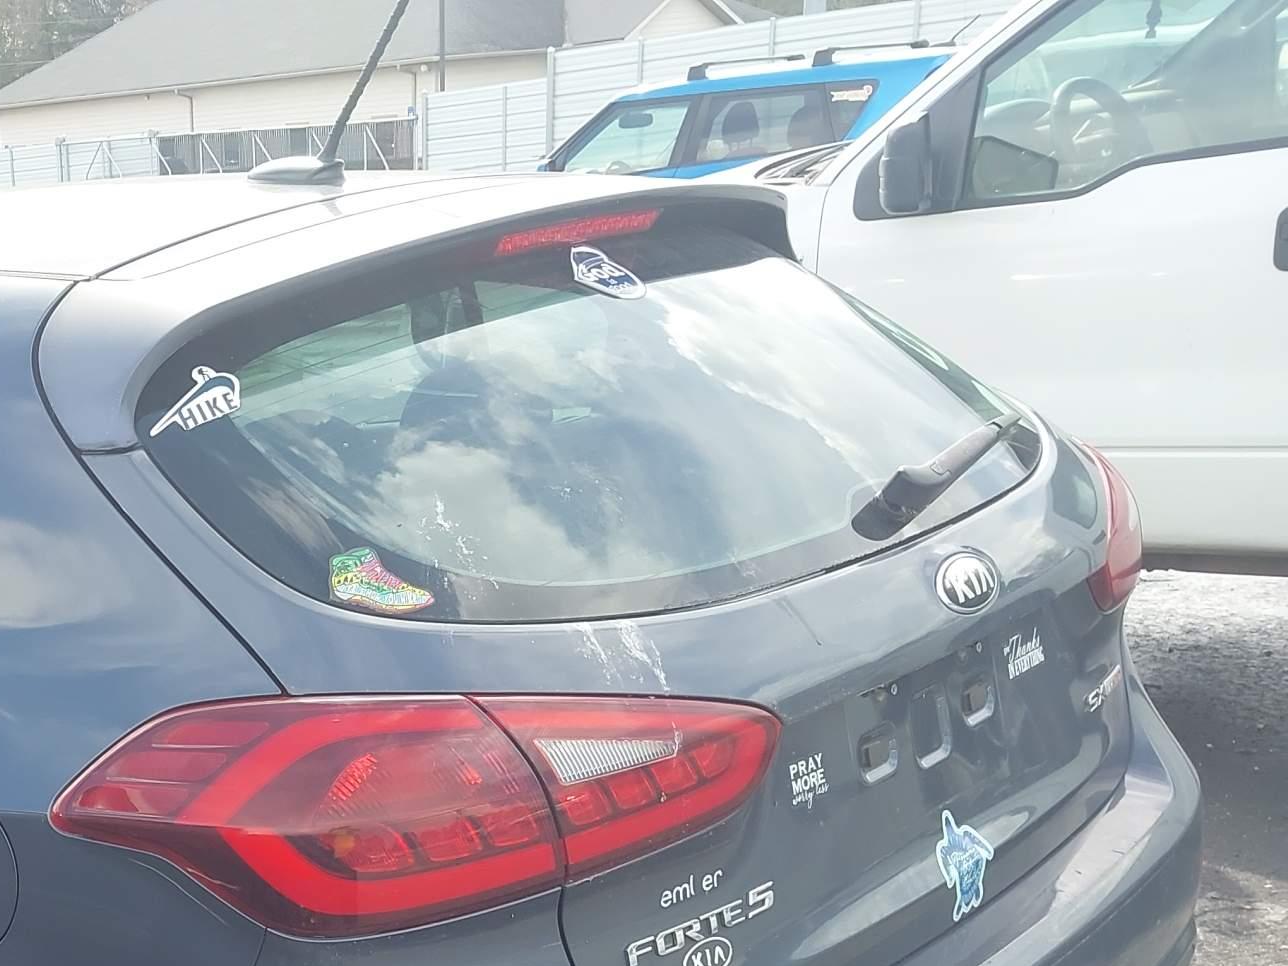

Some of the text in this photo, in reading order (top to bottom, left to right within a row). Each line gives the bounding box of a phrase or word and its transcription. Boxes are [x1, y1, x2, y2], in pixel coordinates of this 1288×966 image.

[578, 262, 626, 282] God
[178, 392, 238, 430] HIKE
[943, 561, 995, 604] KIA
[1009, 627, 1041, 664] Thanks
[789, 752, 822, 780] PRAY
[791, 768, 826, 796] MORE
